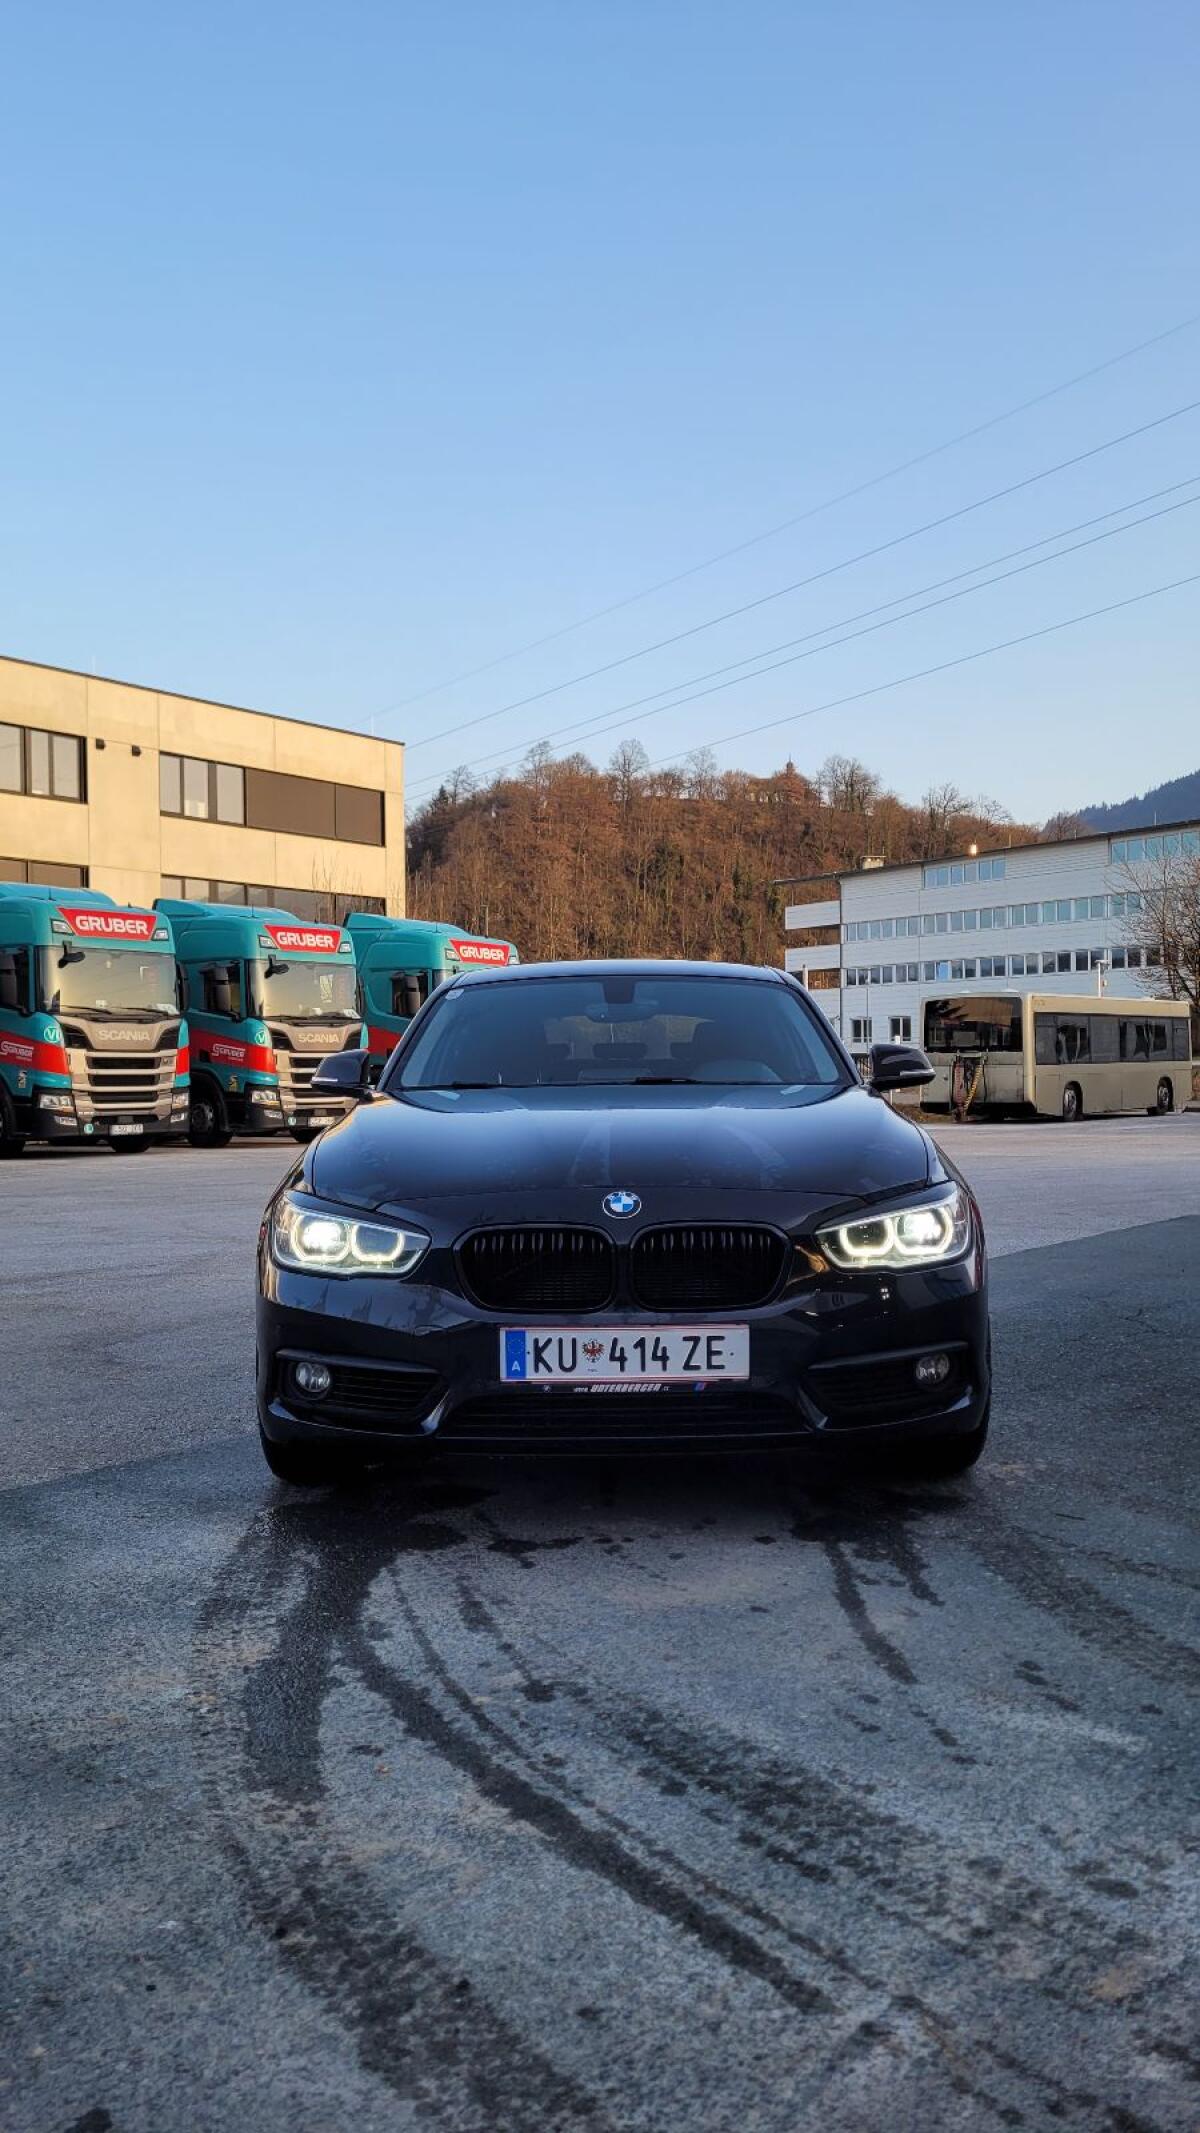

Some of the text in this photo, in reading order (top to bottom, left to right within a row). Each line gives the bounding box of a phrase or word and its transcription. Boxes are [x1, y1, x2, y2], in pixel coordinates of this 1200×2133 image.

[75, 915, 149, 935] GRUBER
[276, 931, 335, 949] GRUBER
[459, 945, 506, 961] GRUBER
[97, 1029, 151, 1041] SCANIA
[297, 1033, 340, 1043] SCANIA
[533, 1335, 726, 1373] KU 414 ZE
[511, 1360, 521, 1371] A
